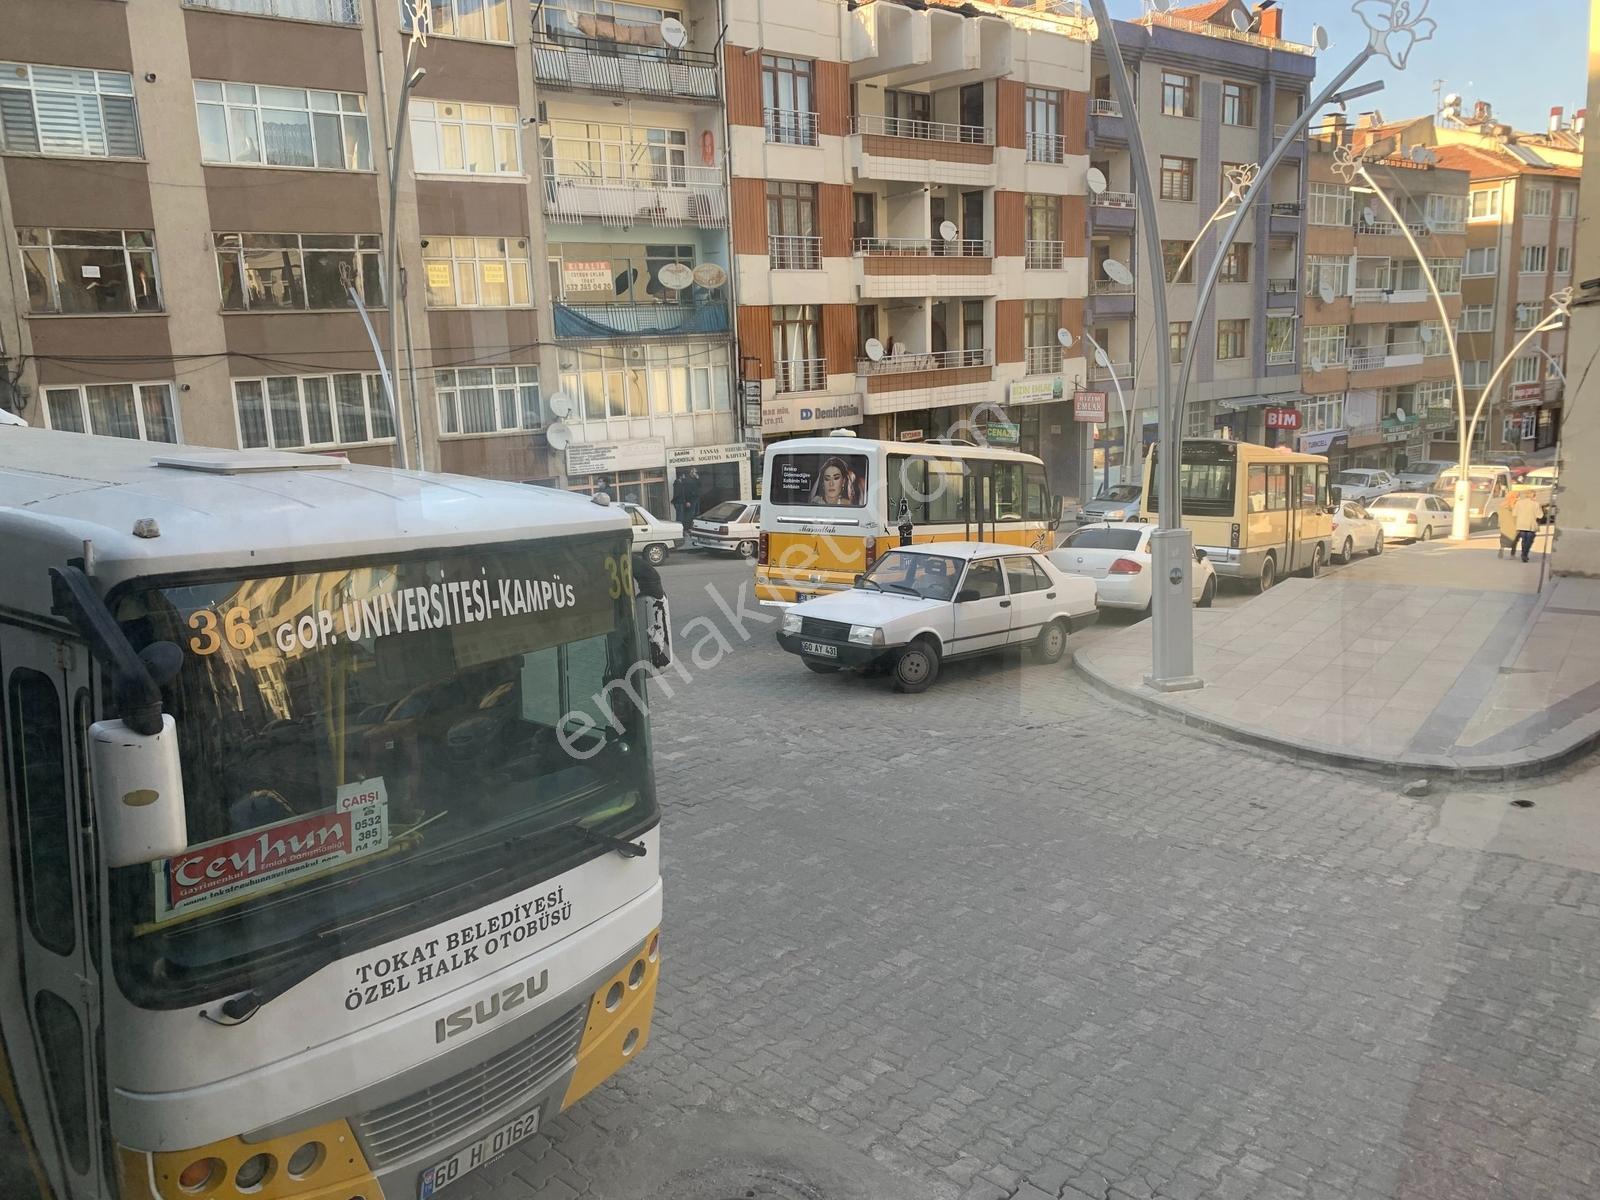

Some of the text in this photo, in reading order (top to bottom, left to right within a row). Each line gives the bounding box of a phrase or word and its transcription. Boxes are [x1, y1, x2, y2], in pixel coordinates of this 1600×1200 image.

[1267, 409, 1297, 426] BİM
[187, 605, 257, 655] 36
[276, 621, 339, 654] GOP.
[342, 790, 379, 811] ÇARŞI
[355, 815, 382, 831] 0532
[175, 822, 344, 886] Ceyhun
[344, 902, 572, 1011] ÖZEL HALK OTOBÜSÜ
[356, 885, 564, 985] TOKAT BELEDİYESİ
[435, 968, 549, 1044] ISUZU
[434, 1157, 459, 1189] 60
[470, 1143, 483, 1168] H
[493, 1114, 535, 1154] 0162
